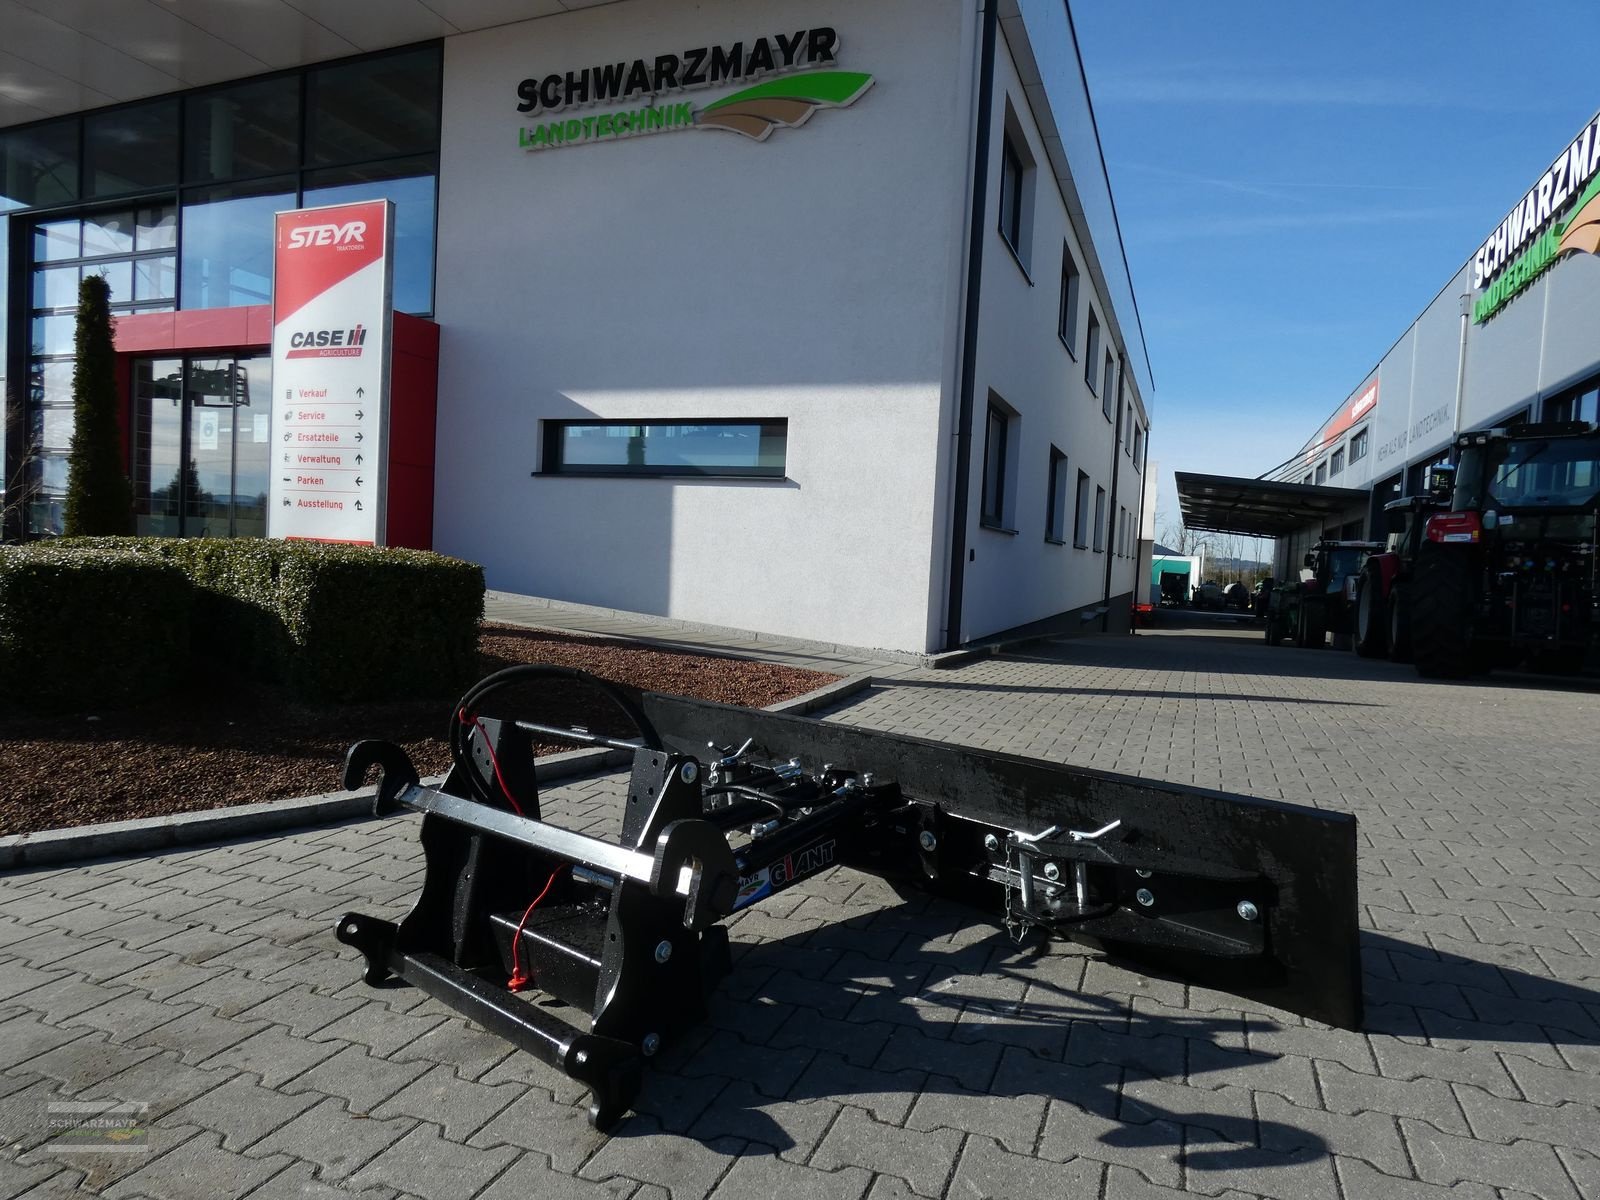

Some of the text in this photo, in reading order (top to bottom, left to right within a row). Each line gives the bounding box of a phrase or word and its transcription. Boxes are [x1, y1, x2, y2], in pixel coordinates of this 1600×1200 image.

[516, 26, 838, 114] SCHWARZMAYR
[519, 101, 693, 148] LANDTECHNIK
[287, 221, 367, 249] STEYR
[336, 244, 365, 252] TRAKTOREN
[1473, 223, 1562, 325] LANDTECHNIK
[290, 330, 344, 348] CASE
[320, 348, 361, 357] AGRICULTURE
[298, 388, 327, 398] Verkauf
[298, 411, 326, 420] Service
[297, 432, 339, 442] Ersatzteile
[297, 454, 341, 465] Verwaltung
[297, 476, 324, 485] Parken
[297, 499, 343, 510] Ausstellung
[769, 838, 836, 887] GIANT
